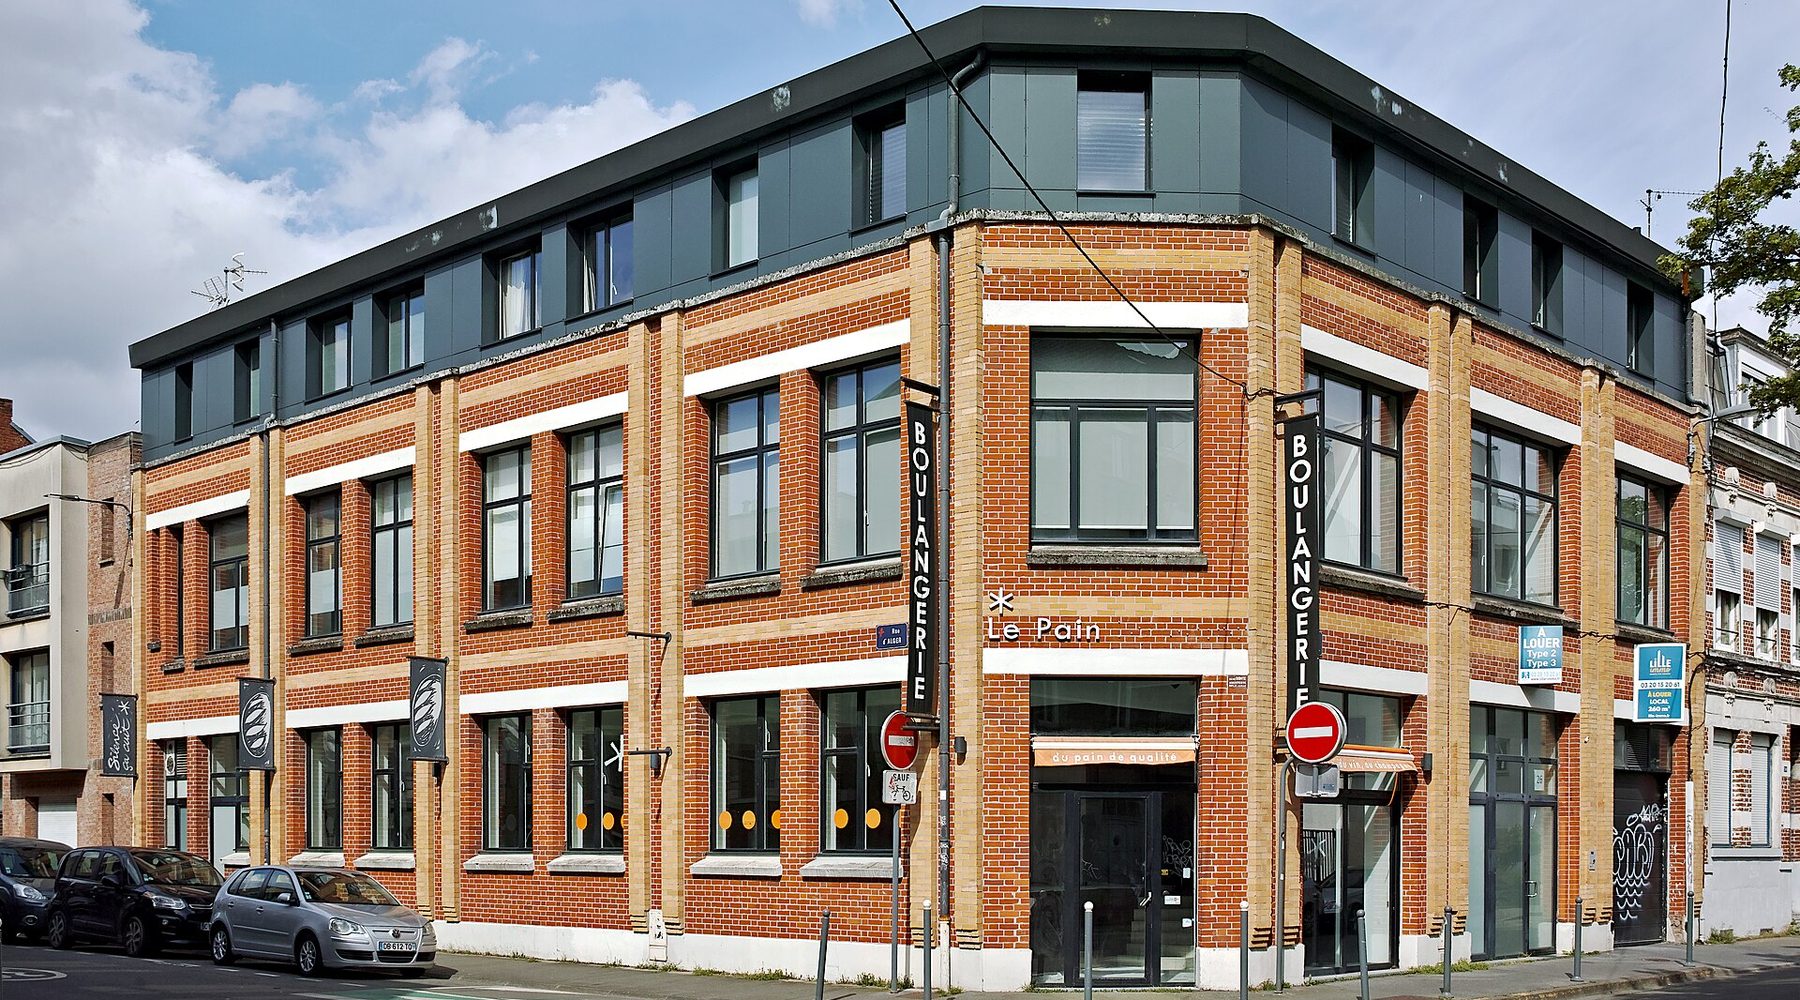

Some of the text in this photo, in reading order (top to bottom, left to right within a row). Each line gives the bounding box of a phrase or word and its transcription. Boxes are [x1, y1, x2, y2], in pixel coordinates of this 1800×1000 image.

[912, 421, 931, 700] BOULANGERIE
[988, 616, 1101, 642] Le Pain
[1523, 637, 1561, 649] LOUER
[1526, 649, 1557, 659] Type 2
[1526, 658, 1557, 669] Type 3
[1653, 690, 1672, 698] LOUER
[108, 714, 121, 771] Silence
[1052, 752, 1177, 763] du pain de qualité
[893, 773, 910, 782] SAUF
